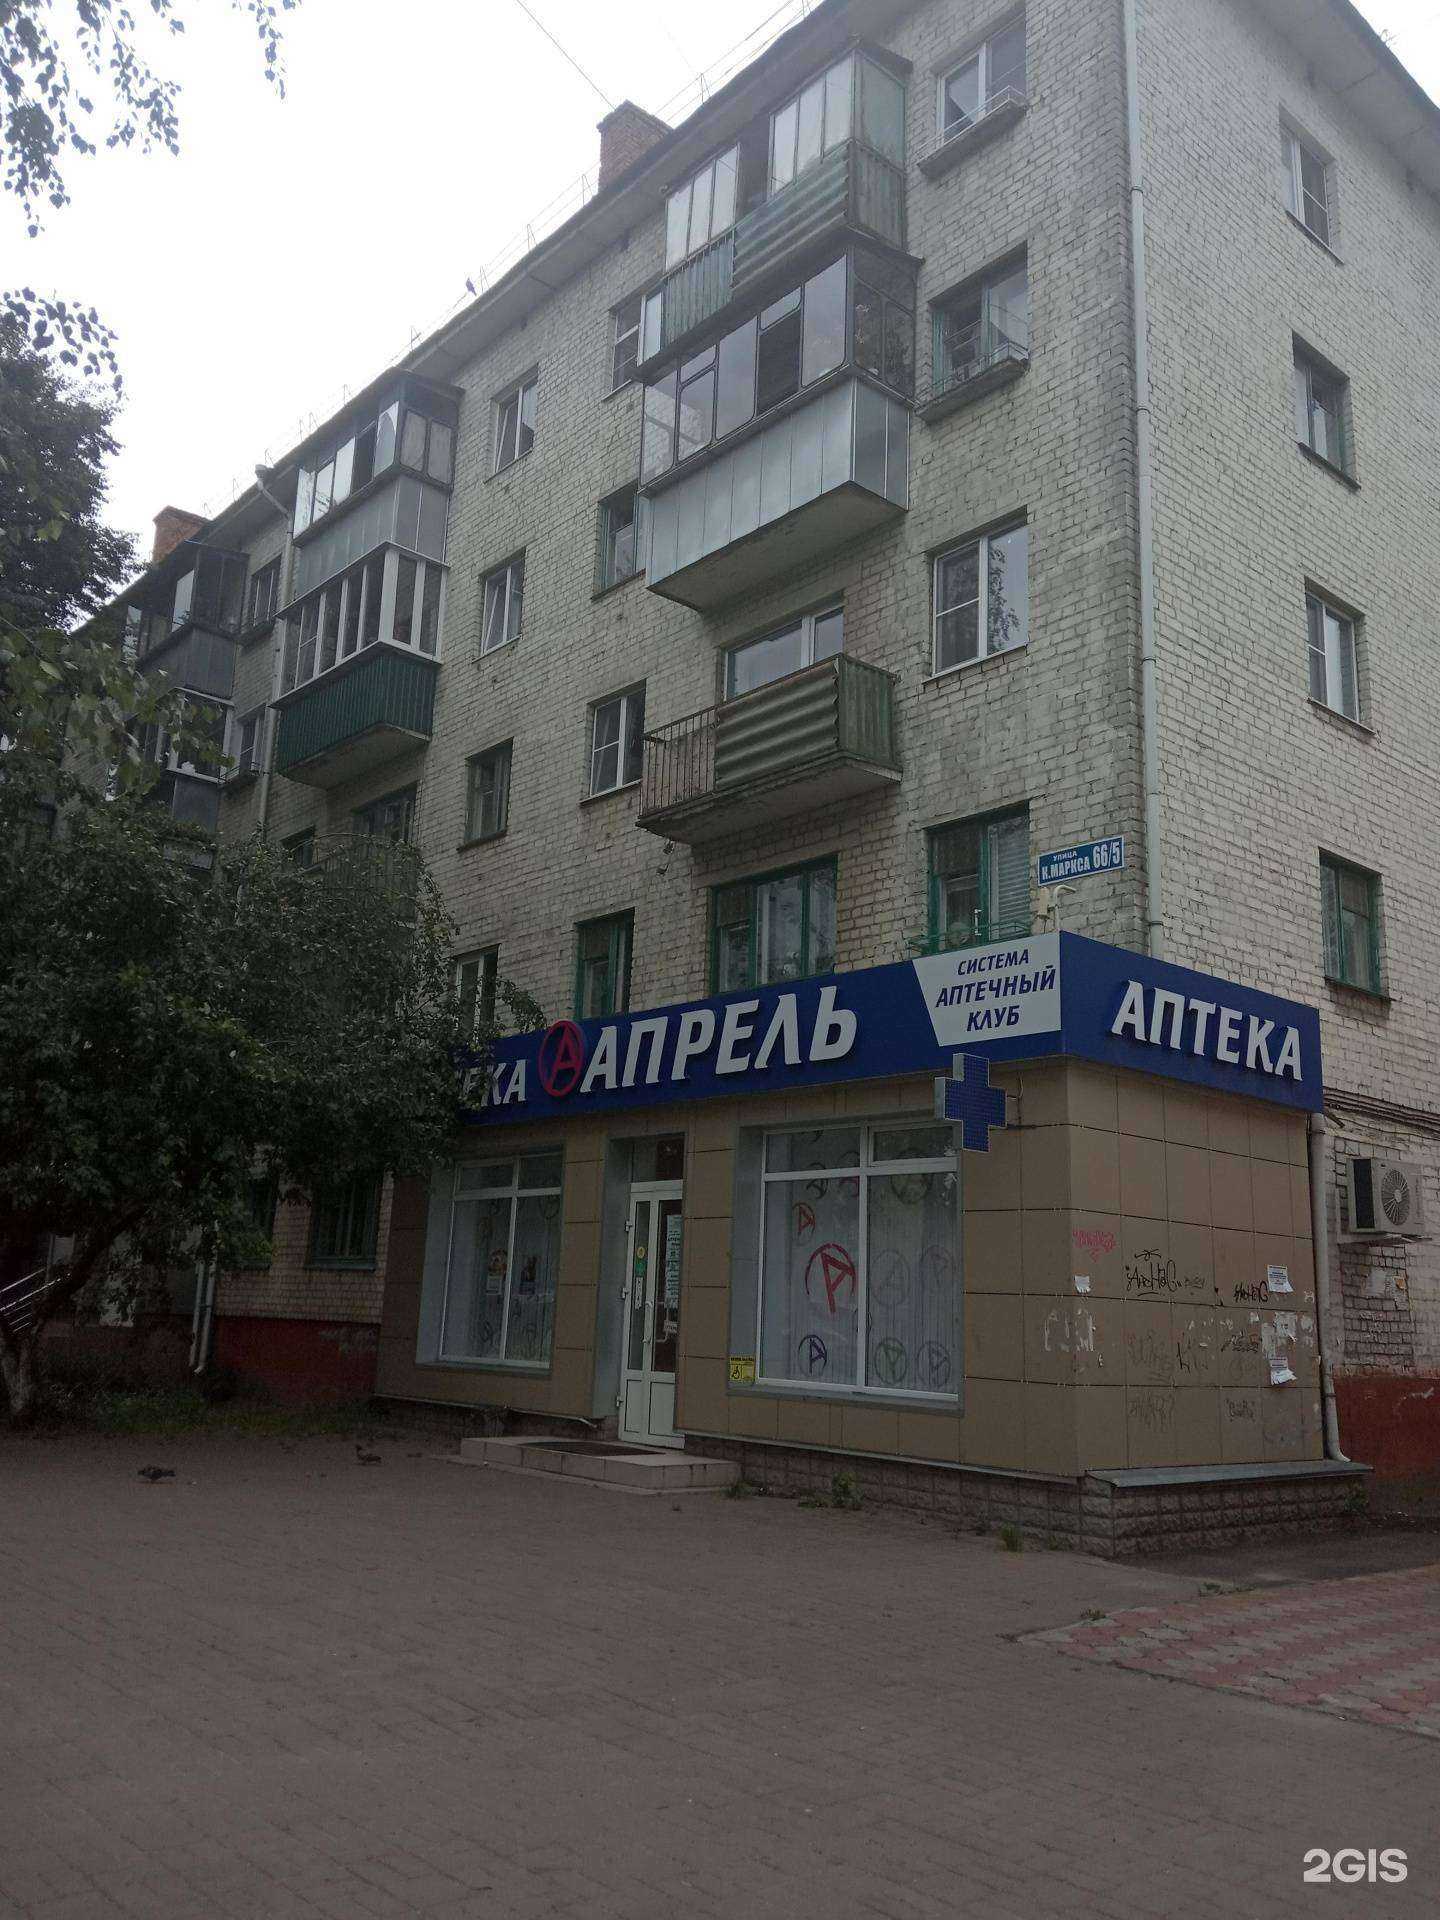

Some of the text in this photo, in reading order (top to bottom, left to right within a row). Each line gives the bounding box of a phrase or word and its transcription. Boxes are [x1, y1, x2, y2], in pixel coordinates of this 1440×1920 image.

[1053, 851, 1077, 861] УЛИЦА
[1093, 841, 1120, 868] 66/5
[957, 949, 1029, 976] СИСТЕМА
[936, 964, 1056, 1008] АПТЕЧНЫЙ
[966, 1005, 1020, 1032] КЛУБ
[1111, 980, 1303, 1081] АПТЕКА
[579, 985, 858, 1093] АПРЕЛЬ
